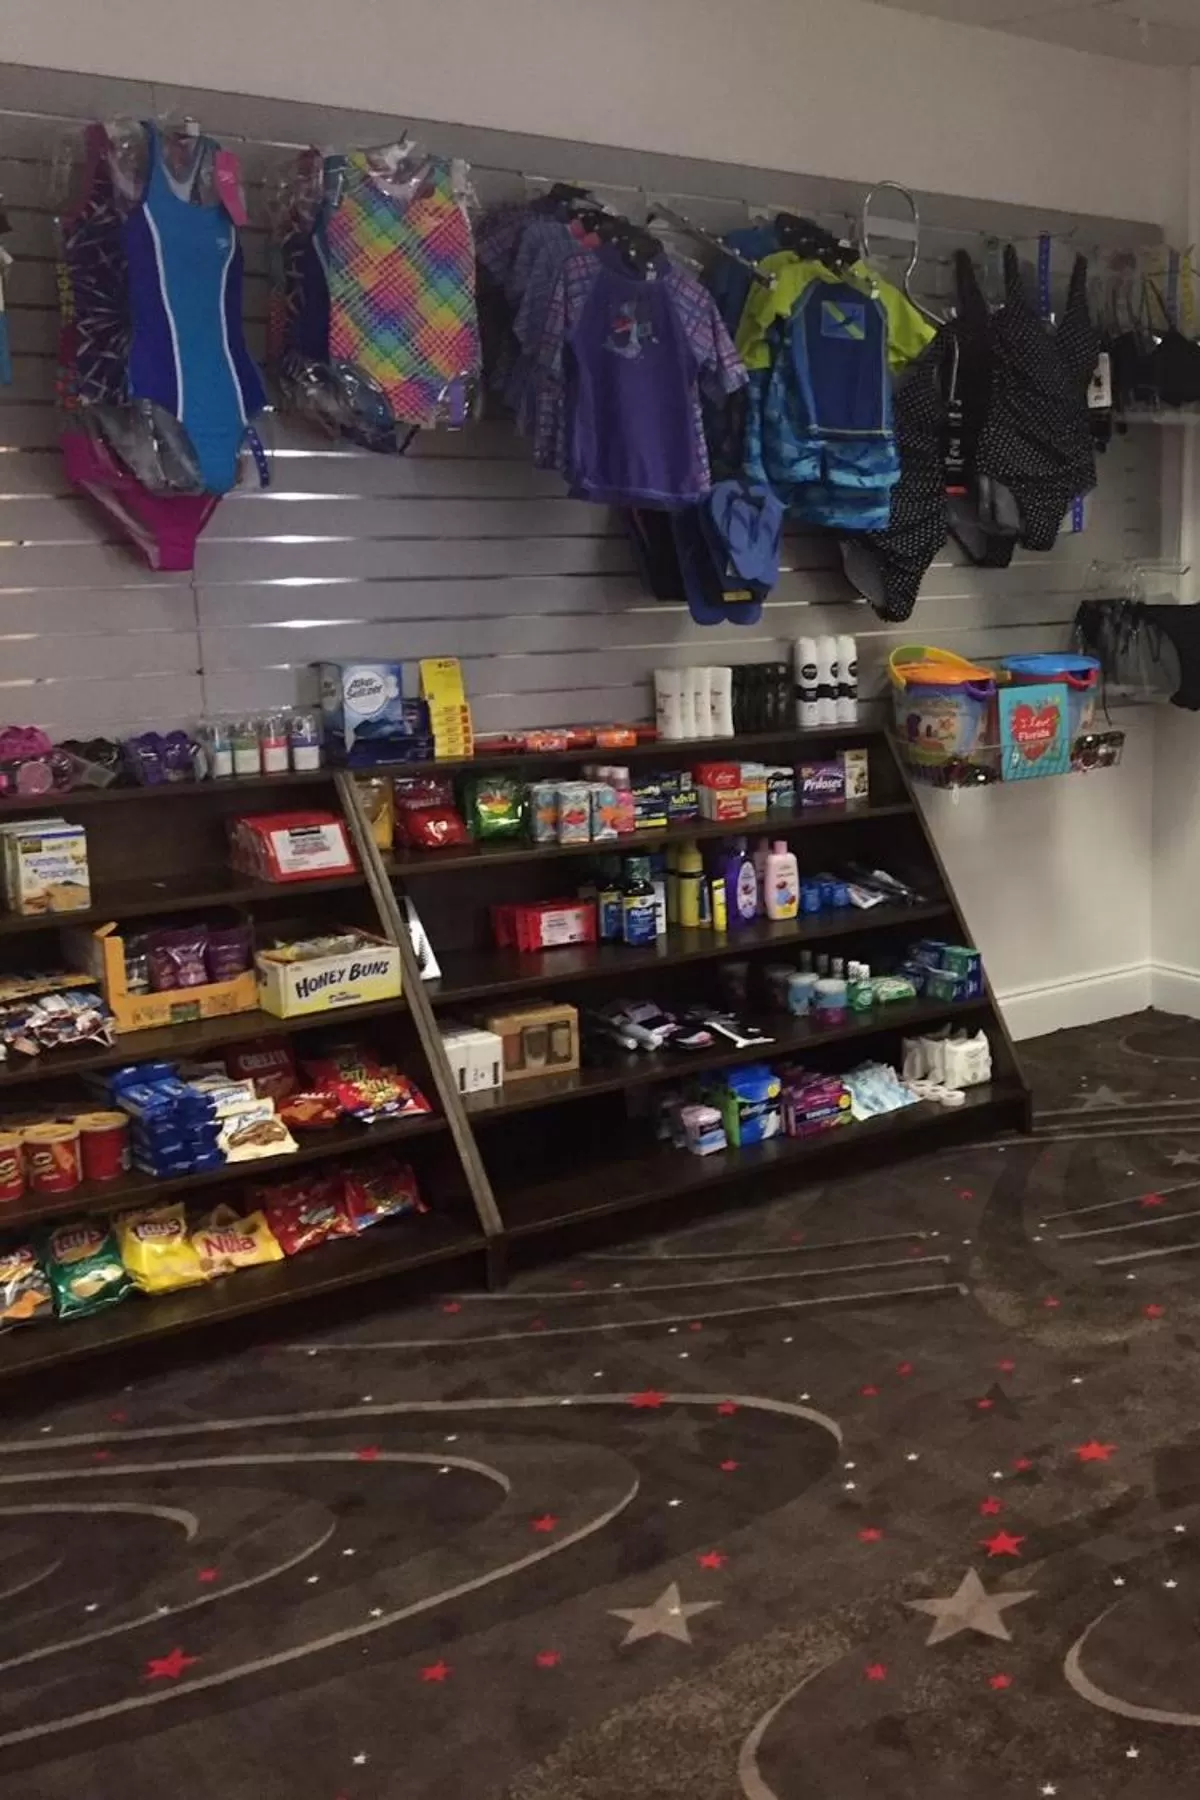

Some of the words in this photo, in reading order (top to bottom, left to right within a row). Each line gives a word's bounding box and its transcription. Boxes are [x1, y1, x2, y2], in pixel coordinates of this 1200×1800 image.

[295, 968, 346, 999] HONEY
[348, 960, 390, 982] BUNS
[202, 1235, 257, 1258] Nilla
